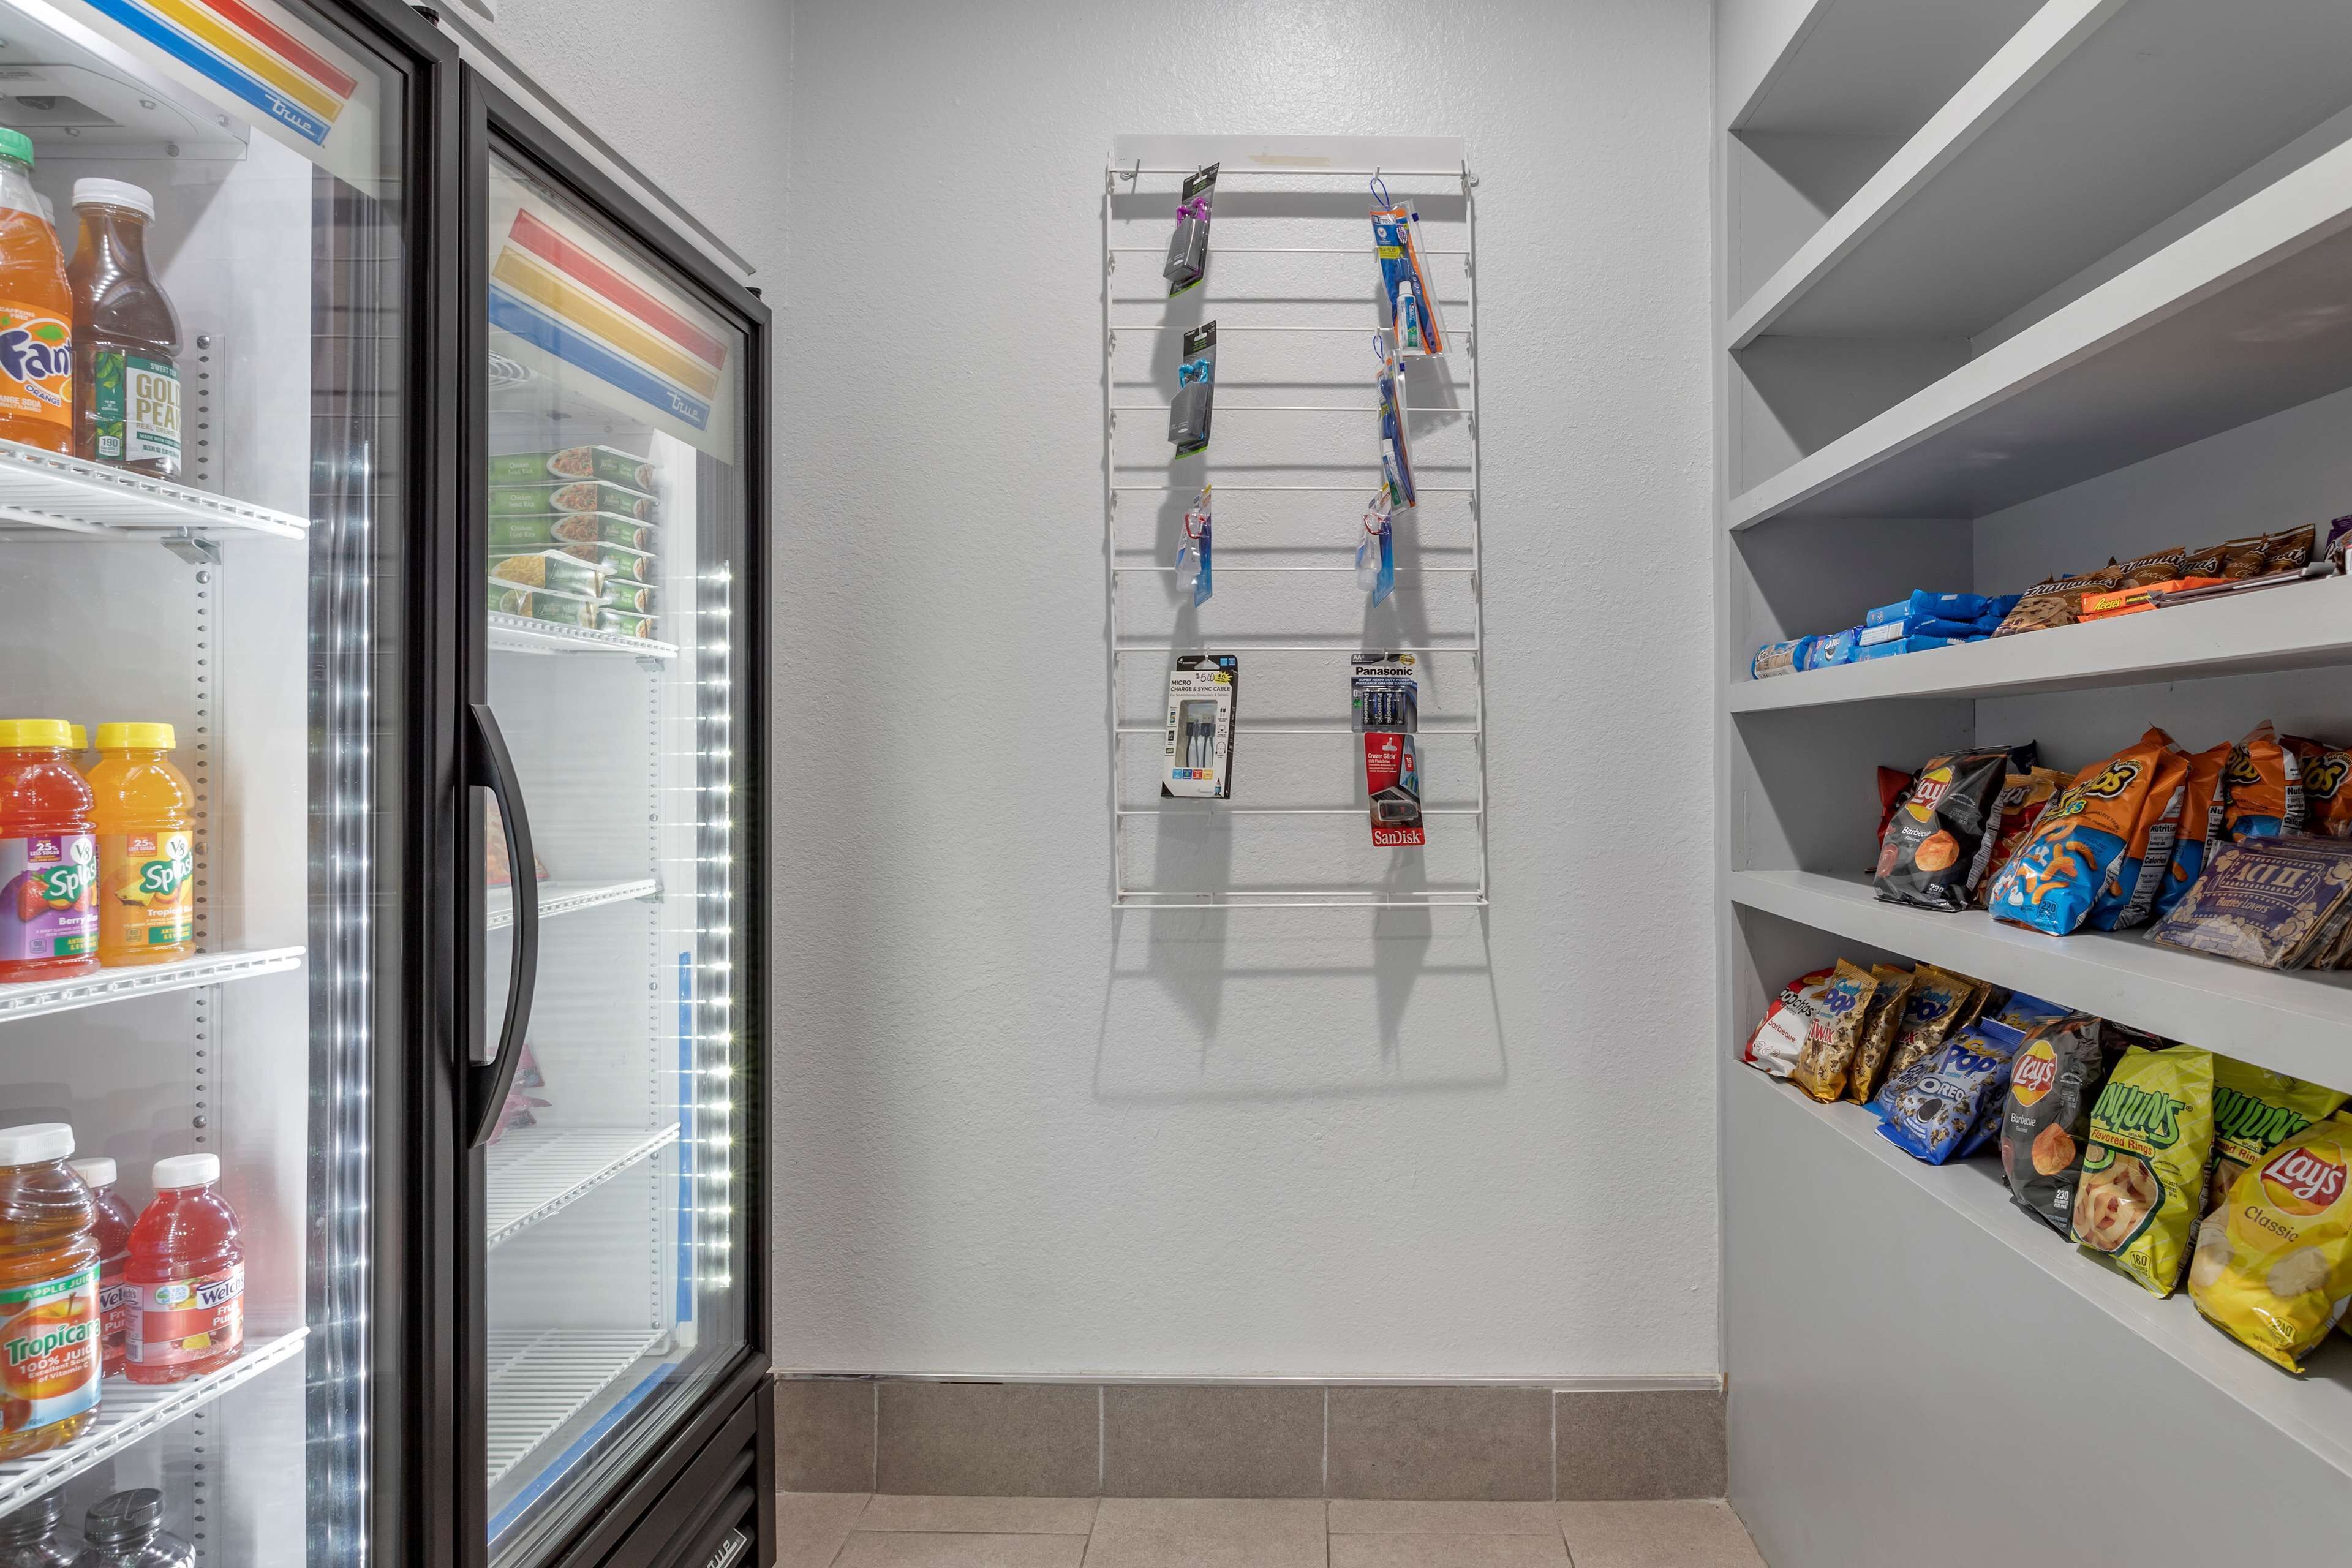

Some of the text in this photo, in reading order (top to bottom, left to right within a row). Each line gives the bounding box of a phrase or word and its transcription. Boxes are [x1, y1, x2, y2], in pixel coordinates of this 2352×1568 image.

[265, 94, 315, 136] true
[150, 363, 168, 374] SWEET
[21, 398, 42, 408] SODA
[25, 385, 62, 406] ORANGE
[666, 392, 700, 421] true
[102, 437, 118, 447] 190
[2093, 597, 2122, 611] Reese's
[1355, 666, 1413, 676] Panasonic
[1374, 830, 1421, 845] SanDisk
[1902, 826, 1931, 837] Barbecue
[36, 843, 58, 851] 25%
[75, 842, 90, 861] V8
[171, 839, 186, 856] V8
[2233, 862, 2309, 888] ACT II
[1929, 883, 1944, 893] 230
[2041, 900, 2056, 913] 220
[2216, 896, 2270, 914] Butter Lovers
[59, 916, 85, 925] Berry
[1823, 988, 1856, 1017] POP
[1768, 1019, 1796, 1043] barbeque
[1939, 1044, 1997, 1078] POP
[2014, 1055, 2055, 1091] Lay's
[1918, 1076, 1966, 1101] OREO
[2011, 1113, 2037, 1127] Barbecue
[2091, 1129, 2152, 1156] Flavored Rings
[2265, 1149, 2343, 1199] Lay's
[2056, 1189, 2068, 1200] 230
[2244, 1205, 2299, 1242] Classic
[2133, 1254, 2147, 1267] 180
[23, 1271, 96, 1300] APPLE JUICE
[5, 1317, 100, 1365] Tropicana
[20, 1355, 60, 1374] 100%
[28, 1362, 69, 1378] Excellent
[39, 1373, 49, 1382] of
[49, 1365, 81, 1378] Vitamin
